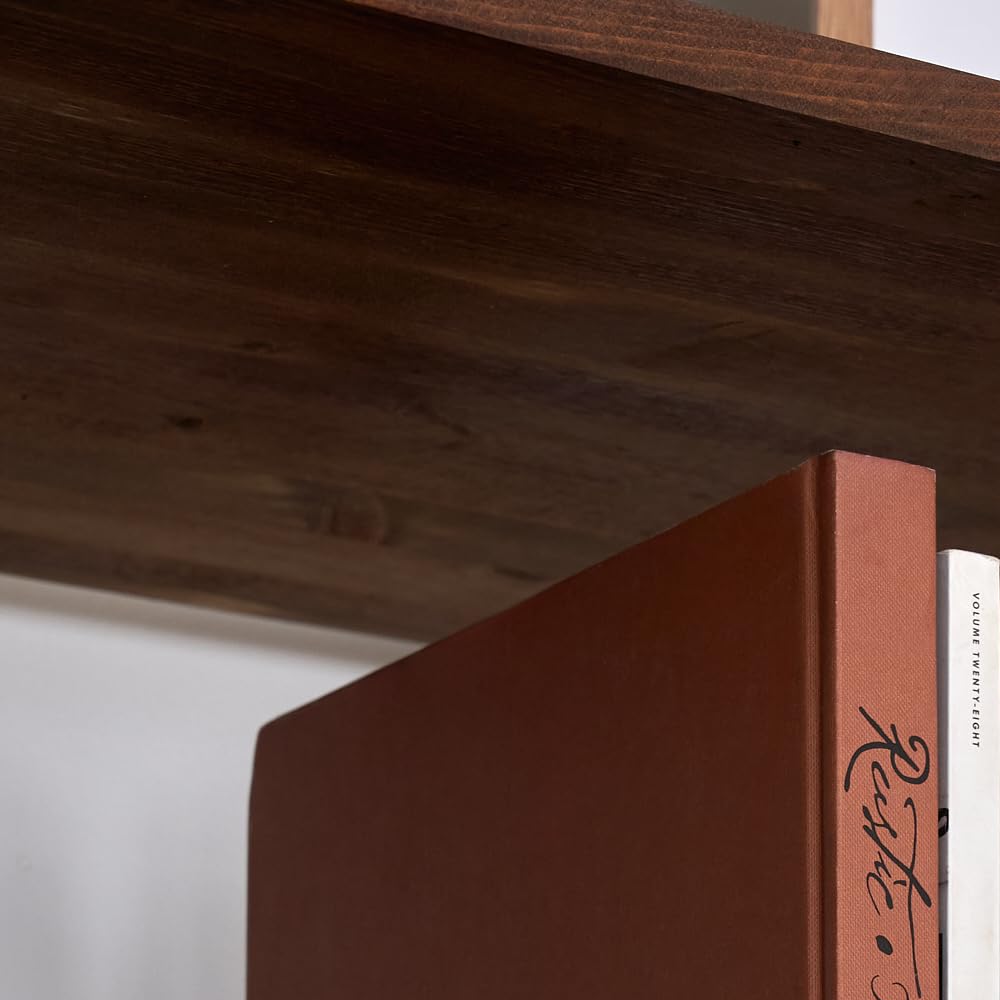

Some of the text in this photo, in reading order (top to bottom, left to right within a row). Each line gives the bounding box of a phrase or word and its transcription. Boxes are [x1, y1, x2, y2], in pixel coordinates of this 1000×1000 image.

[972, 592, 980, 748] VOLUME TWENTY-EIGHT
[843, 706, 932, 998] Rustic
